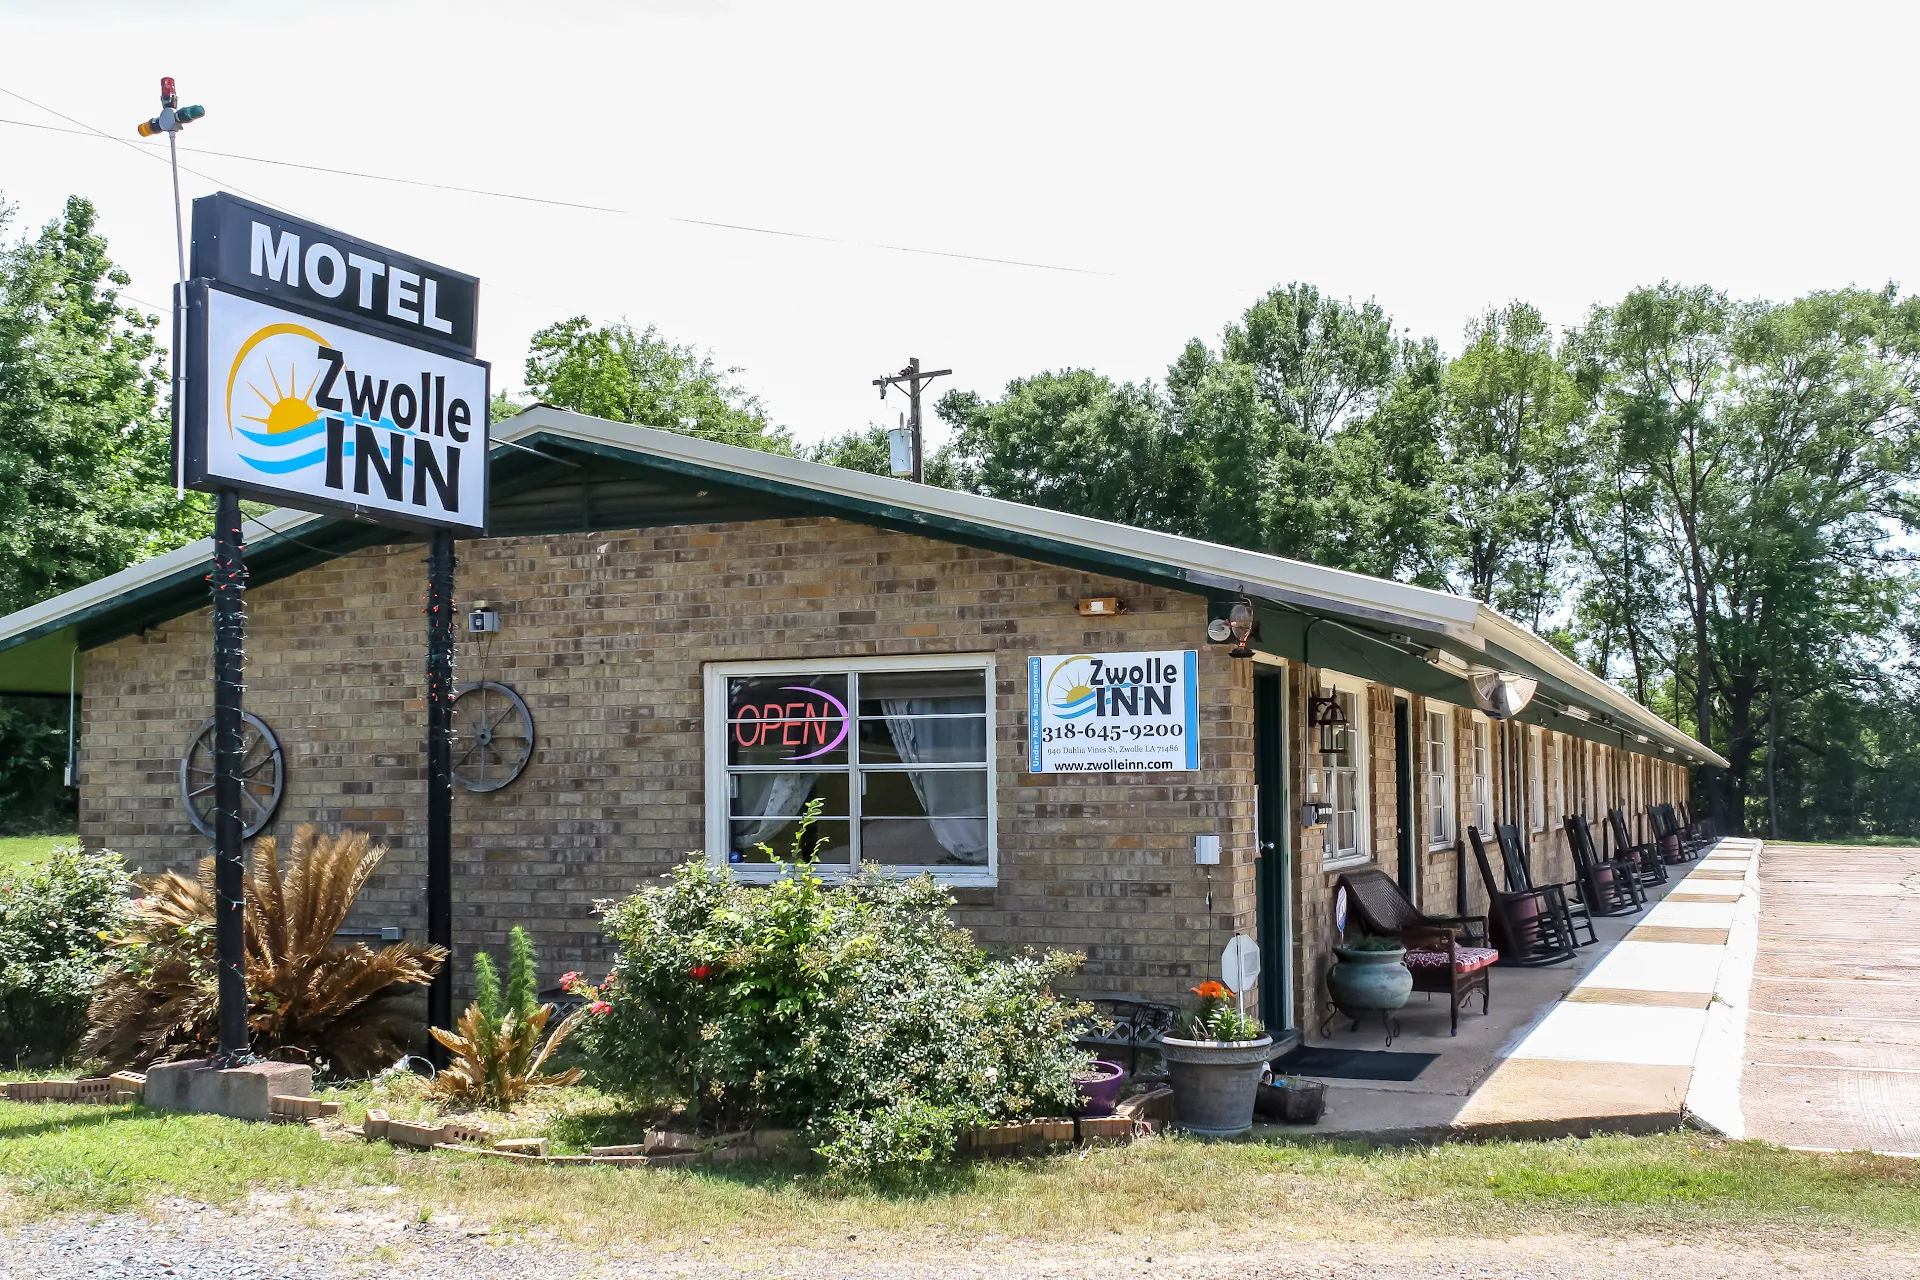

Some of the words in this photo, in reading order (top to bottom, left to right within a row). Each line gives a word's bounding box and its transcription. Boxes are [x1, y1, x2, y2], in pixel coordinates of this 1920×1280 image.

[250, 220, 453, 334] MOTEL
[315, 345, 472, 443] Zwolle
[324, 417, 461, 513] INN
[1090, 657, 1178, 686] Zwolle
[1032, 660, 1040, 717] Management
[1096, 686, 1172, 717] INN
[735, 702, 828, 747] OPEN
[1042, 722, 1183, 743] 318-645-9200
[1032, 740, 1040, 767] Under
[1054, 758, 1173, 771] www.zwolleinn.com
[1063, 746, 1086, 754] Dahlia
[1087, 745, 1107, 754] Vines
[1108, 745, 1118, 754] St,
[1119, 744, 1143, 753] Zwolle
[1145, 745, 1155, 753] LA
[1156, 744, 1179, 754] 71486
